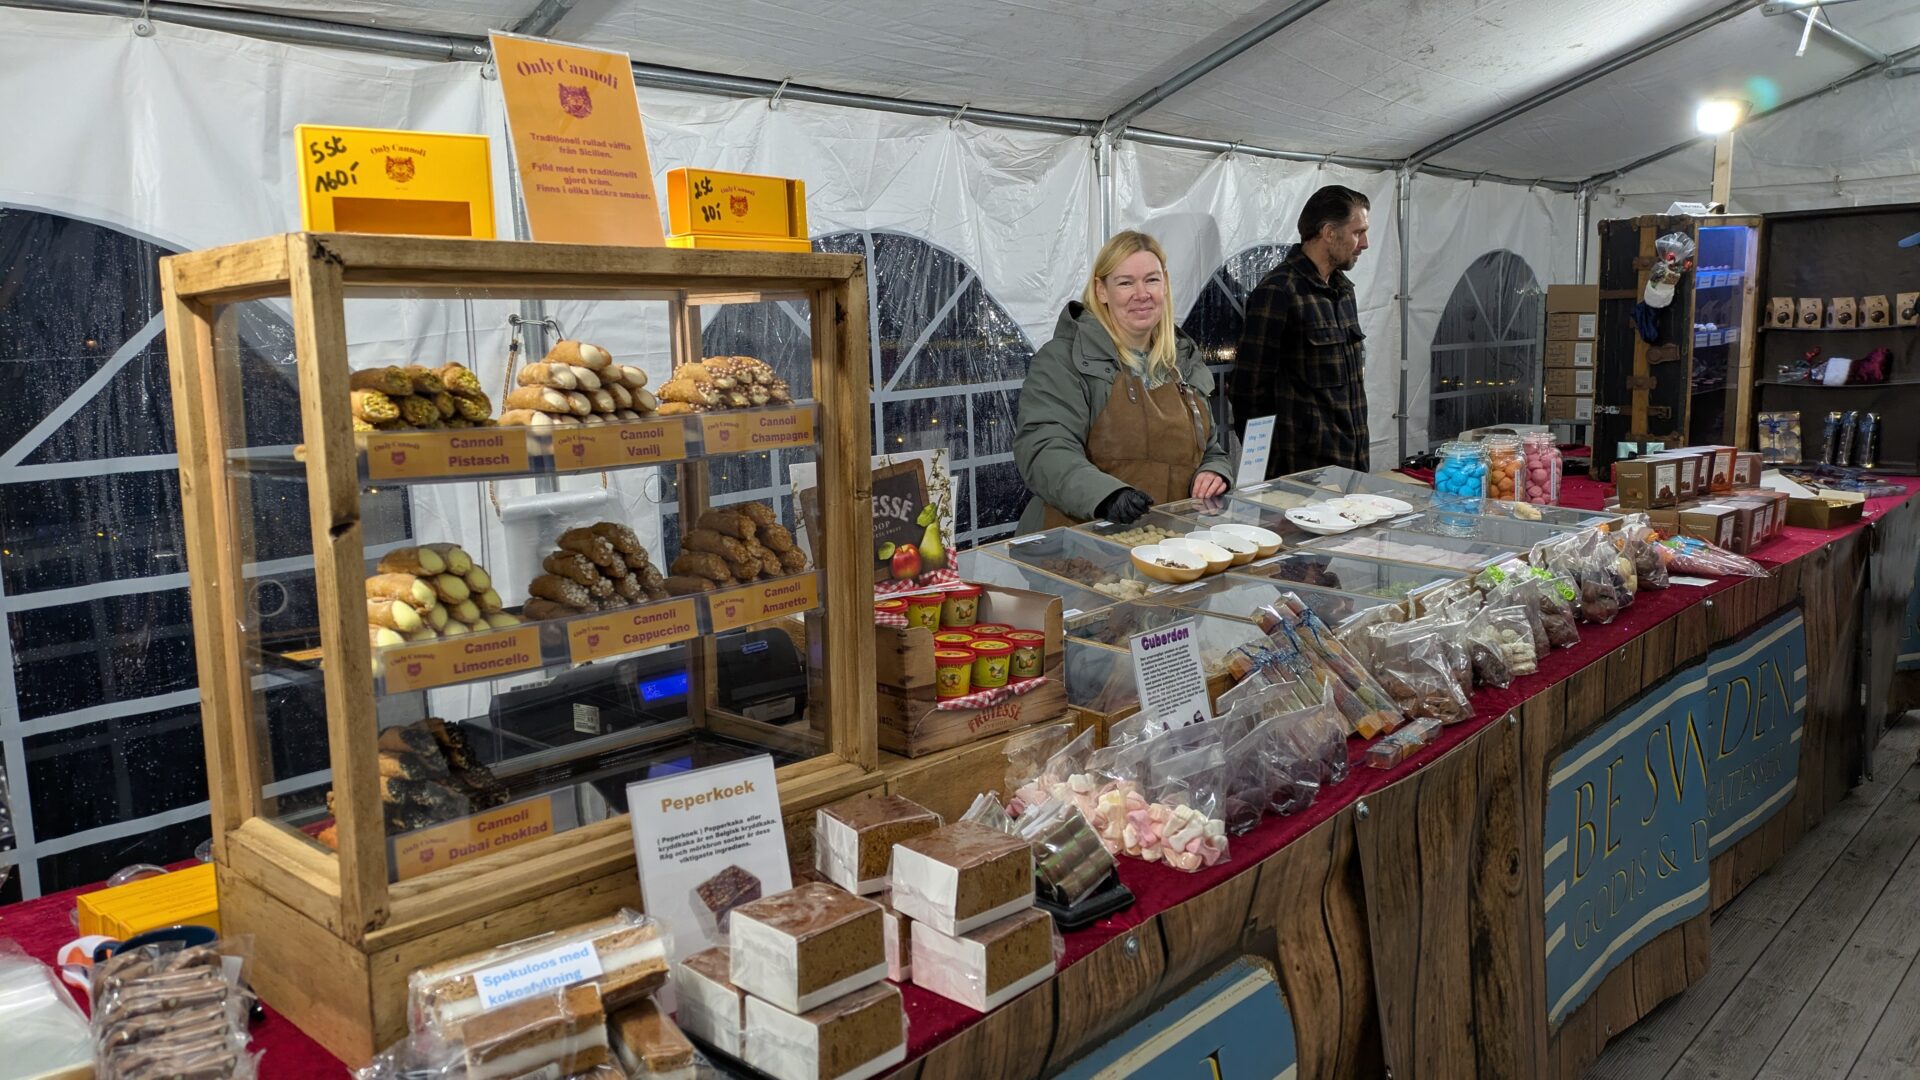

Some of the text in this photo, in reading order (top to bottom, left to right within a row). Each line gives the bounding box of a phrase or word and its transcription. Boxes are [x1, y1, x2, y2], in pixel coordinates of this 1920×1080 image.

[517, 58, 618, 89] Only Cannoli
[530, 132, 631, 150] Traditionell rullad våffla
[559, 146, 613, 158] från Sicilien.
[532, 162, 553, 172] Fylld
[590, 168, 637, 179] traditionellt
[563, 176, 586, 185] gjord
[536, 184, 560, 193] Finns
[568, 186, 589, 195] olika
[591, 188, 618, 197] läckra
[619, 191, 651, 200] smaker.
[759, 416, 796, 427] Cannoli
[450, 436, 503, 449] Cannoli
[620, 427, 664, 441] Cannoli
[751, 430, 809, 444] Champagne
[626, 443, 661, 457] Vanilj
[448, 454, 510, 467] Pistasch
[764, 582, 801, 598] Cannoli
[762, 596, 808, 614] Amaretto
[633, 609, 676, 626] Cannoli
[623, 623, 691, 645] Cappuccino
[1141, 627, 1189, 650] Cuberdon
[464, 636, 516, 655] Cannoli
[454, 653, 529, 674] Limoncello
[1570, 645, 1791, 888] BE SWDEN
[661, 780, 755, 813] Peperkoek
[477, 809, 529, 833] Cannoli
[661, 830, 698, 843] Peperkoek
[704, 819, 743, 832] Pepperkaka
[747, 814, 762, 822] eller
[449, 821, 548, 860] Dubai choklad
[658, 839, 695, 853] kryddkaka
[715, 828, 740, 838] Belgisk
[741, 819, 777, 832] kryddkaka.
[675, 849, 688, 857] och
[689, 840, 722, 853] mörkbrun
[723, 835, 745, 844] socker
[755, 828, 771, 836] dess
[679, 842, 752, 864] viktigaste ingrediens.
[1573, 850, 1648, 949] GODIS
[1656, 834, 1680, 879] &
[482, 947, 590, 988] Spekuloos med
[487, 968, 583, 1006] kokosfyllning
